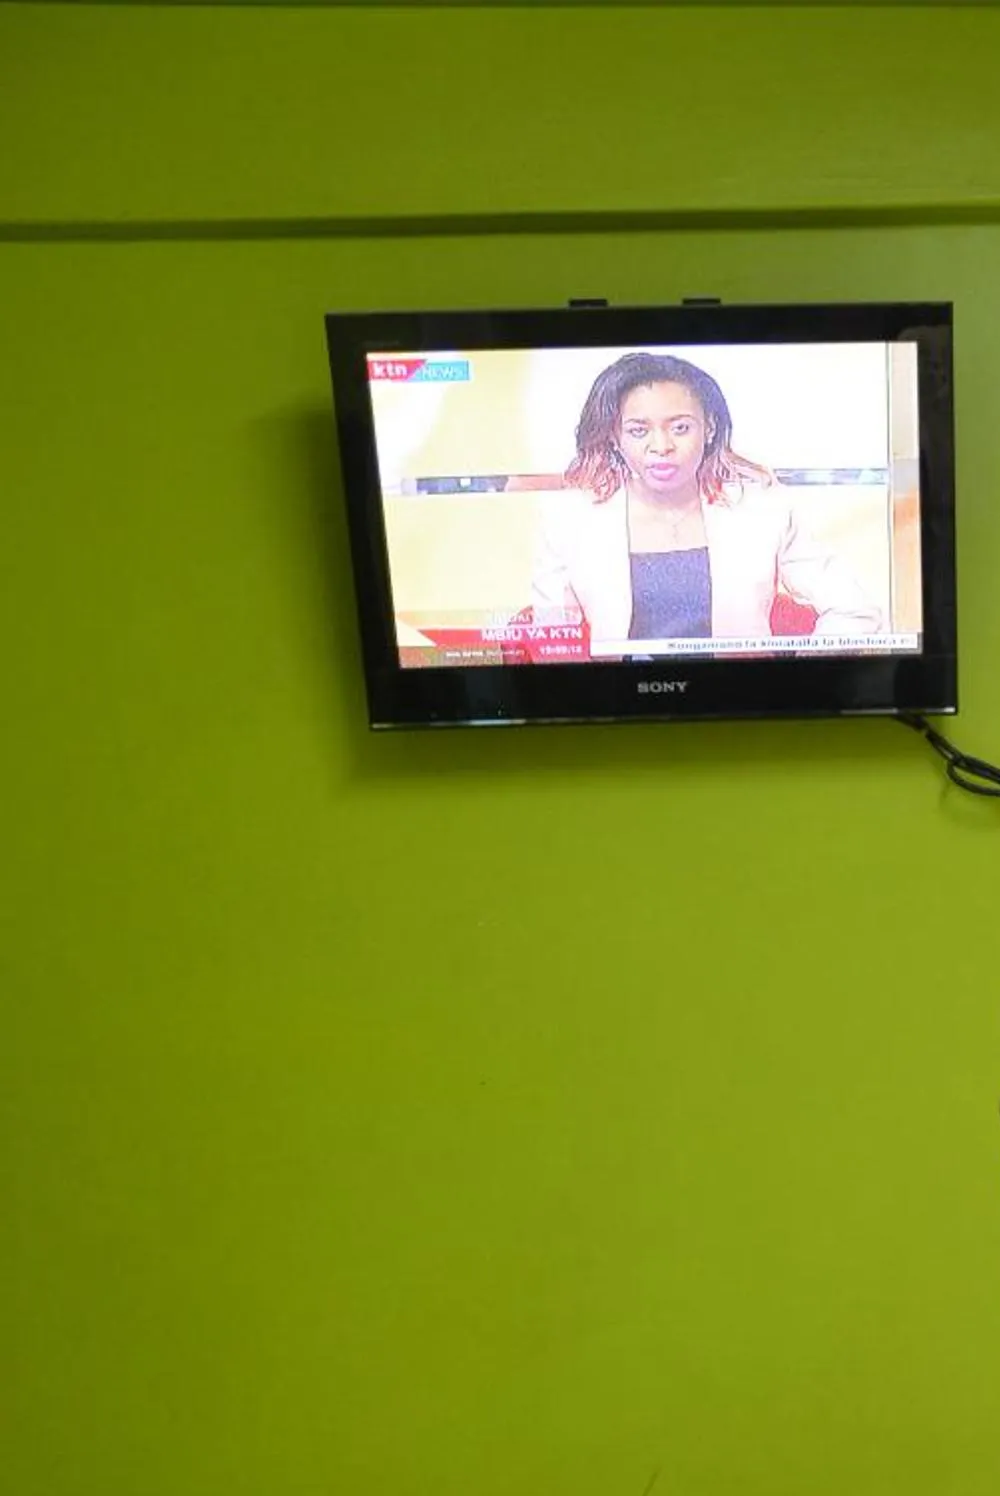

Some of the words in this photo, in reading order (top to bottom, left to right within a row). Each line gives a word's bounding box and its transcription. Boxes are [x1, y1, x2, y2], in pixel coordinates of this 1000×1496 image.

[526, 627, 547, 639] YA
[550, 626, 582, 639] KTN
[637, 681, 688, 693] SONY
